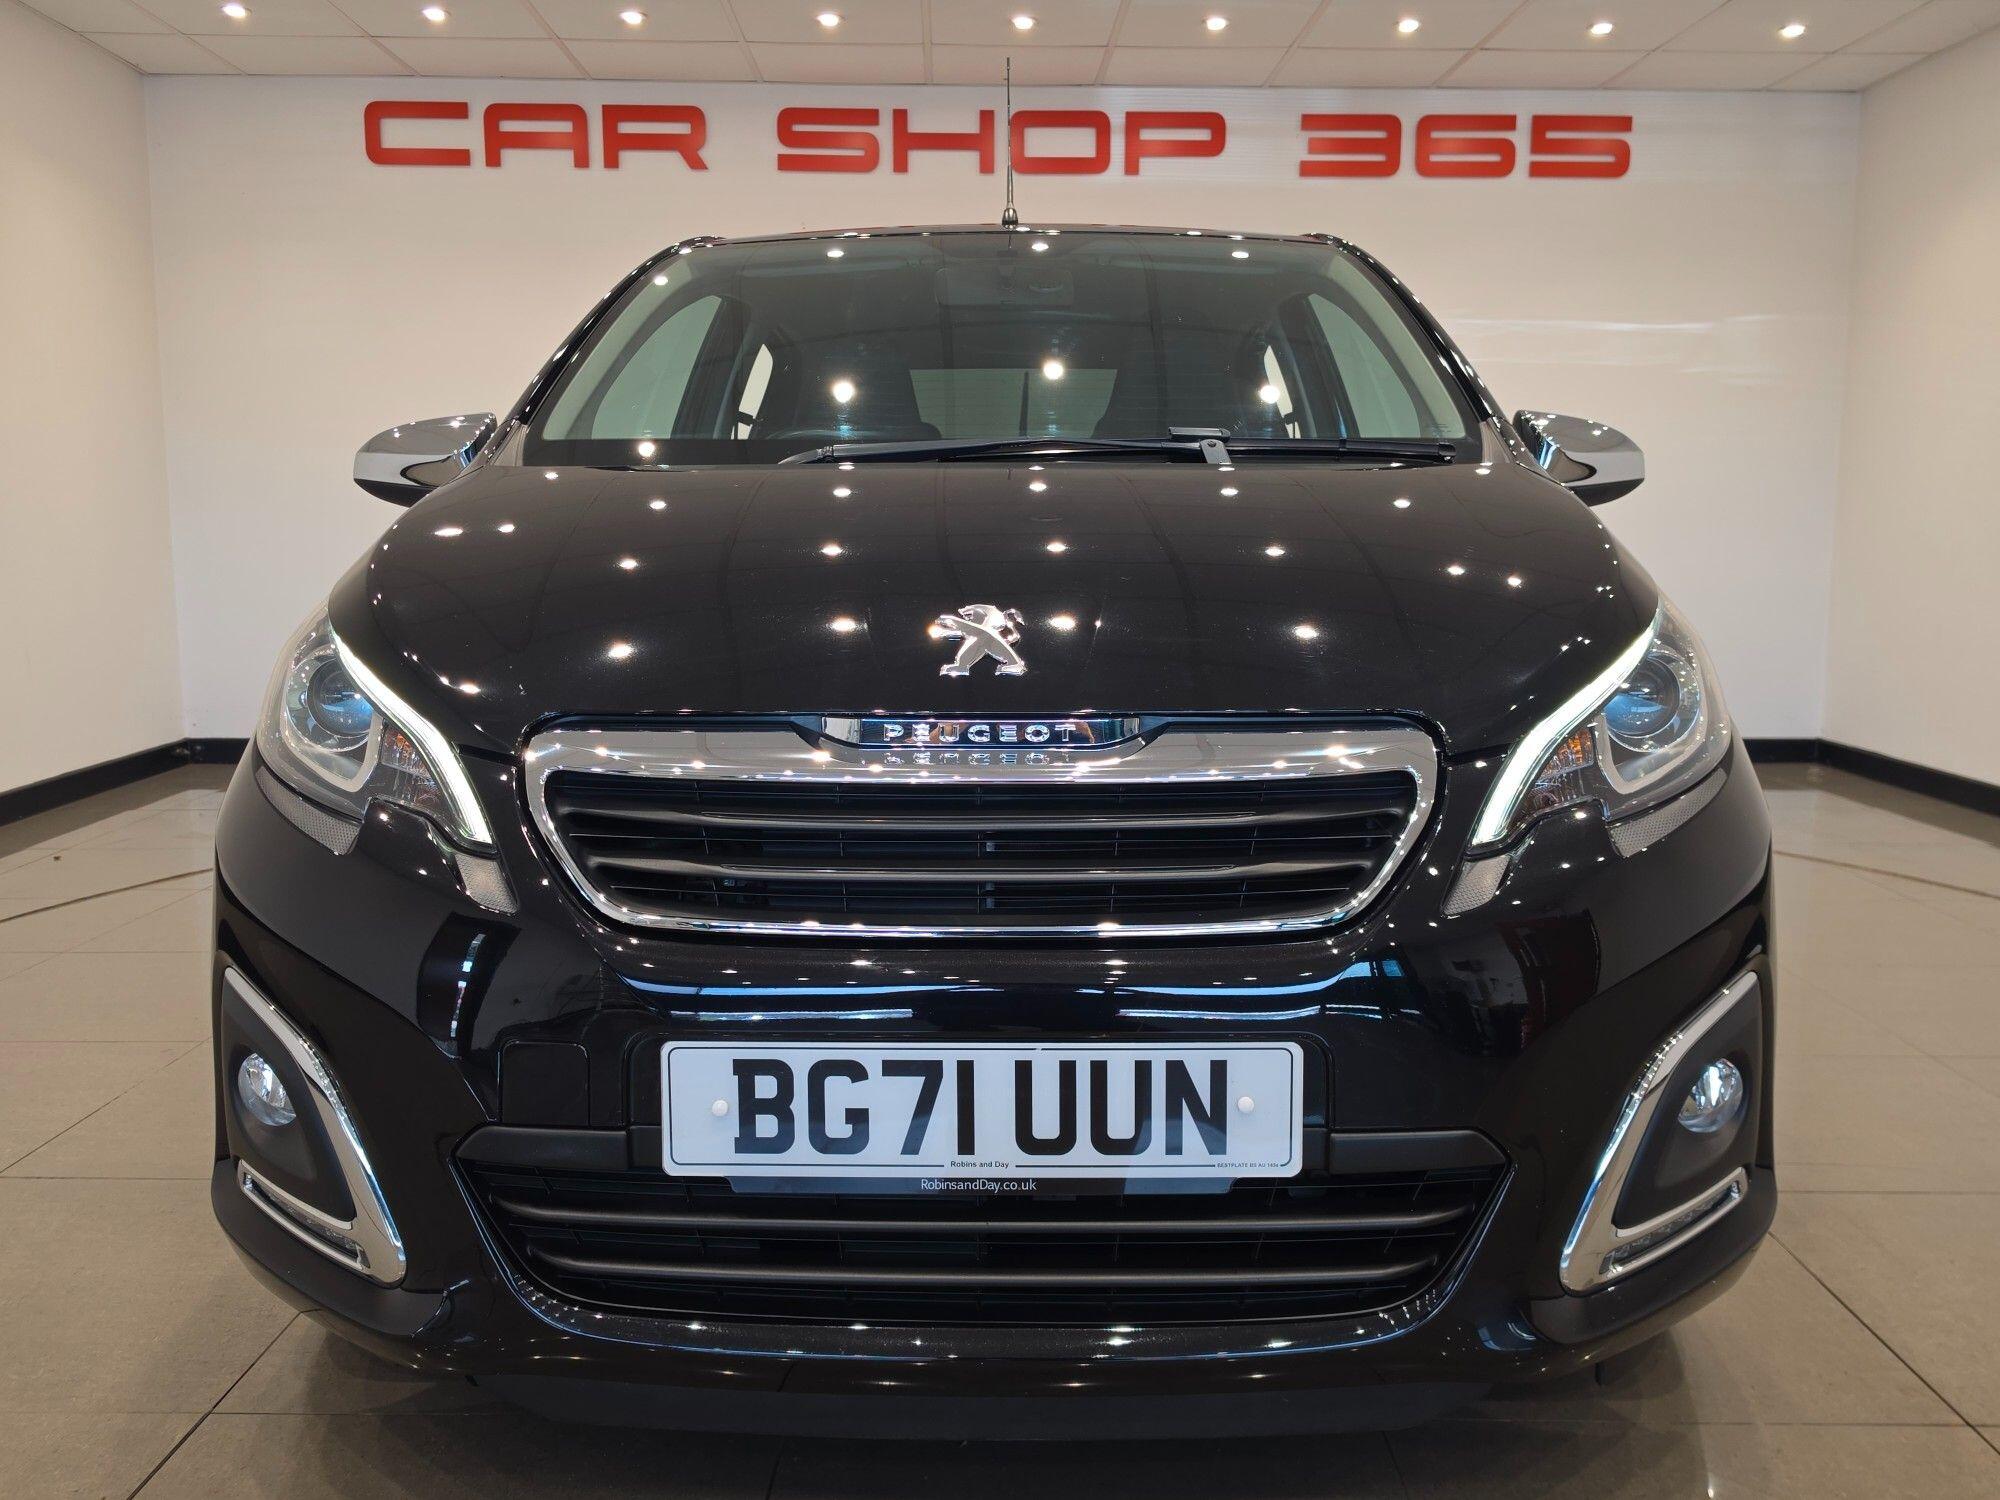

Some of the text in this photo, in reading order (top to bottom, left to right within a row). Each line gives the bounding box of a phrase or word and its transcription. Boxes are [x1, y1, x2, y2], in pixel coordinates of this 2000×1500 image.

[364, 100, 1633, 178] CAR SHOP 365
[883, 723, 1076, 743] PEUGEOT
[732, 1059, 1227, 1156] BG71 UUN
[950, 1160, 1010, 1170] Robins and Day
[921, 1179, 1037, 1194] RobinsandDay.co.uk
